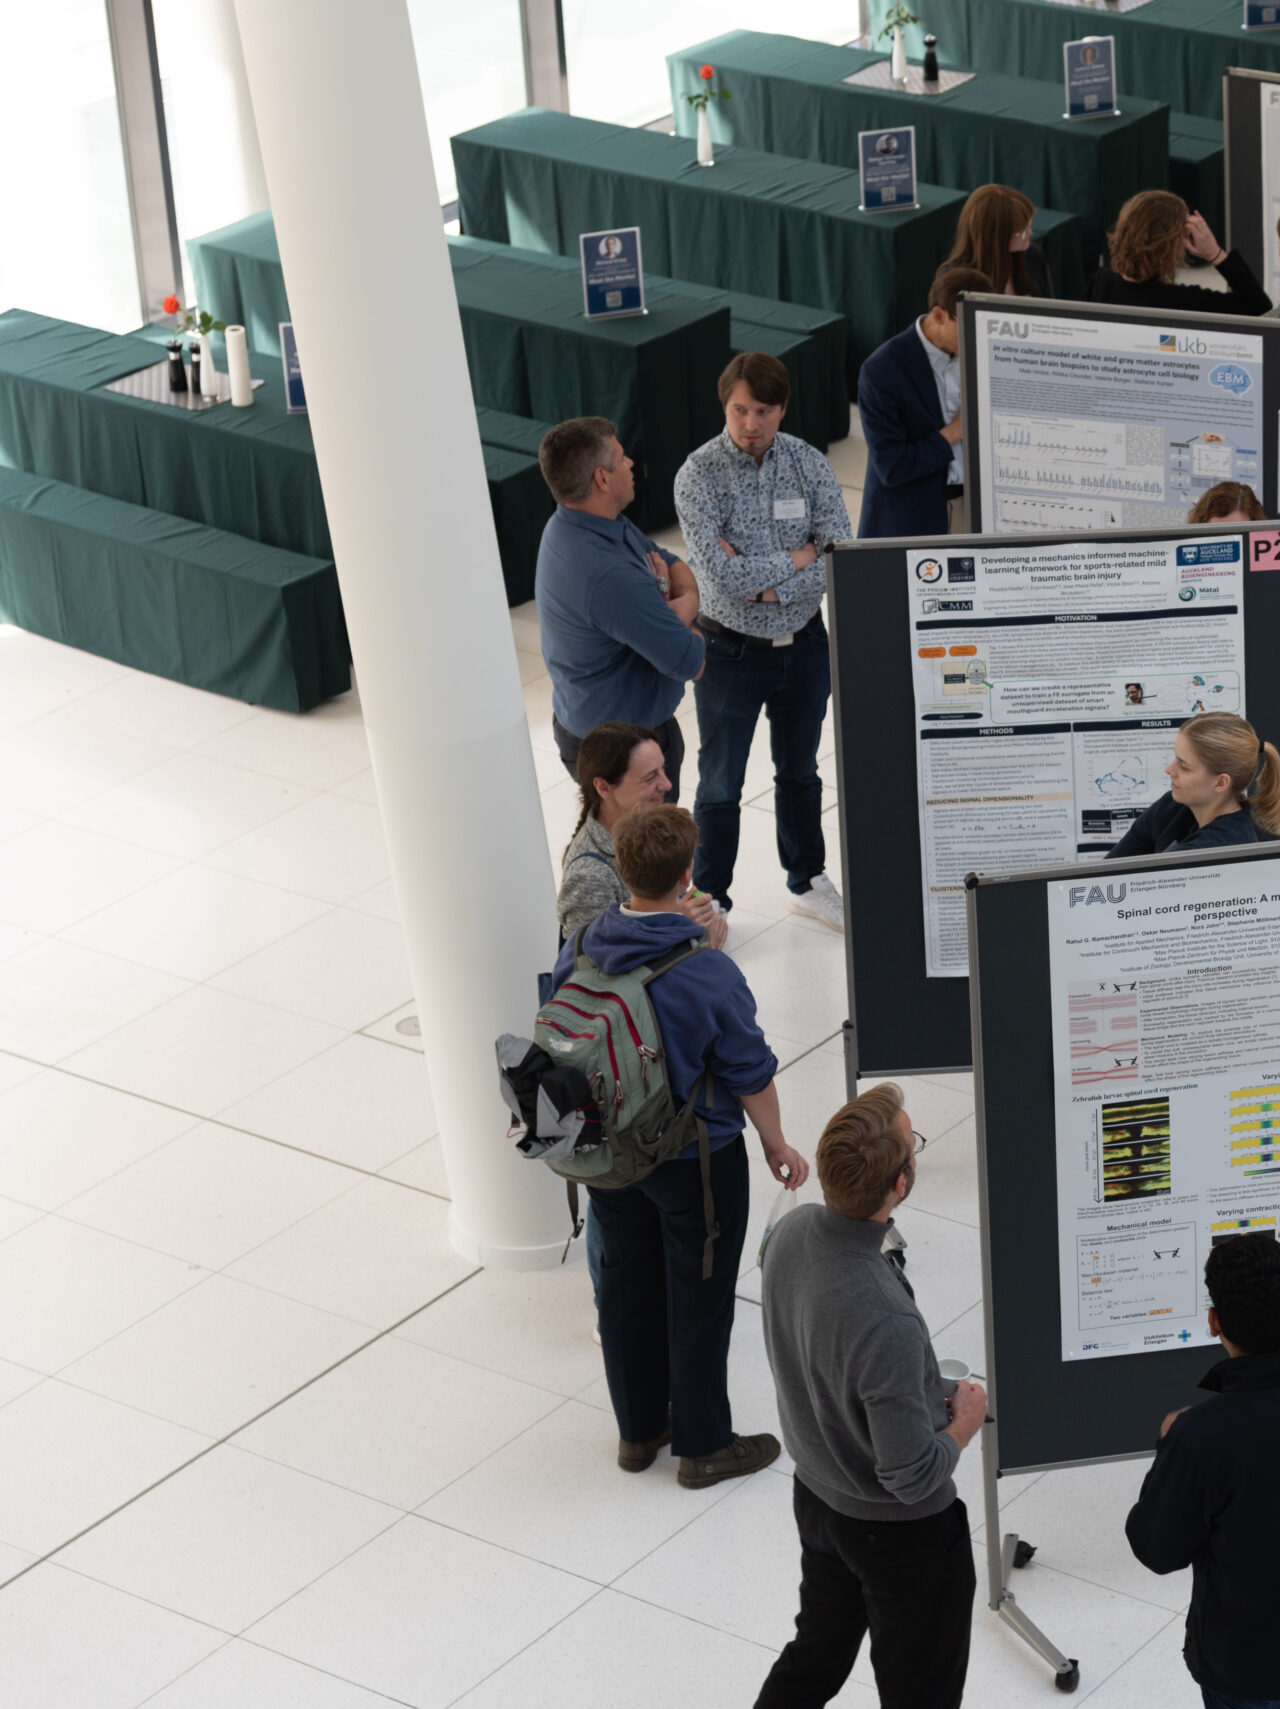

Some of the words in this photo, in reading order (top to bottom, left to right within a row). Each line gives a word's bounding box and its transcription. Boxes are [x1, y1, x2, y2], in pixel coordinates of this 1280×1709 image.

[987, 319, 1029, 339] FAU
[1002, 346, 1019, 354] vitro
[1020, 348, 1046, 356] culture
[1047, 351, 1070, 359] model
[1104, 355, 1118, 363] and
[1119, 358, 1134, 366] gray
[1136, 358, 1161, 367] matter
[1163, 361, 1200, 371] astrocytes
[994, 355, 1012, 363] from
[1013, 356, 1039, 366] human
[1040, 359, 1059, 368] brain
[1060, 362, 1090, 372] biopsies
[1101, 365, 1121, 374] study
[1122, 367, 1156, 377] astrocyte
[1158, 370, 1171, 378] cell
[1172, 371, 1200, 381] biology
[1217, 371, 1245, 384] EBM
[1200, 547, 1234, 556] AUCKLAND
[981, 556, 1030, 568] Developing
[1038, 553, 1086, 563] mechanics
[1087, 550, 1127, 560] informed
[1128, 549, 1169, 558] machine-
[985, 566, 1020, 576] learning
[1021, 562, 1067, 573] framework
[1069, 562, 1082, 571] for
[1083, 558, 1145, 572] sports-related
[1147, 558, 1166, 567] mild
[1181, 566, 1214, 574] AUCKLAND
[1030, 573, 1072, 583] traumatic
[1074, 572, 1095, 581] brain
[1097, 570, 1122, 581] injury
[1181, 570, 1236, 579] BIOENGINEERING
[1055, 614, 1098, 622] MOTIVATION
[1067, 682, 1112, 691] representative
[1061, 690, 1090, 699] surrogate
[1012, 699, 1054, 708] unsupervised
[1007, 706, 1044, 715] mouthguard
[1084, 704, 1110, 712] signals?
[984, 795, 1034, 803] DIMENSIONALITY
[1130, 872, 1221, 887] Friedrich-Alexander-Universität
[1130, 882, 1186, 893] Erlangen-Nürnberg
[1068, 882, 1127, 908] FAU
[1117, 907, 1152, 920] Spinal
[1154, 902, 1180, 915] cord
[1183, 896, 1257, 912] regeneration:
[1260, 893, 1268, 903] A
[1194, 907, 1258, 923] perspective
[1066, 937, 1083, 945] Rahul
[1142, 929, 1158, 937] Oskar
[1227, 918, 1255, 927] Stephanie
[1135, 938, 1155, 947] Applied
[1187, 965, 1232, 976] Introduction
[1140, 1035, 1166, 1043] Mechanical
[1072, 1095, 1102, 1103] Zebrafish
[1104, 1092, 1123, 1100] larvae
[1124, 1089, 1143, 1099] spinal
[1144, 1087, 1158, 1096] cord
[1159, 1082, 1198, 1094] regeneration
[1216, 1206, 1244, 1217] Varying
[1106, 1221, 1148, 1232] Mechanical
[1149, 1217, 1172, 1227] model
[1144, 1332, 1175, 1342] Uniklinikum
[1144, 1338, 1166, 1346] Erlangen
[1083, 1343, 1098, 1351] DFG
